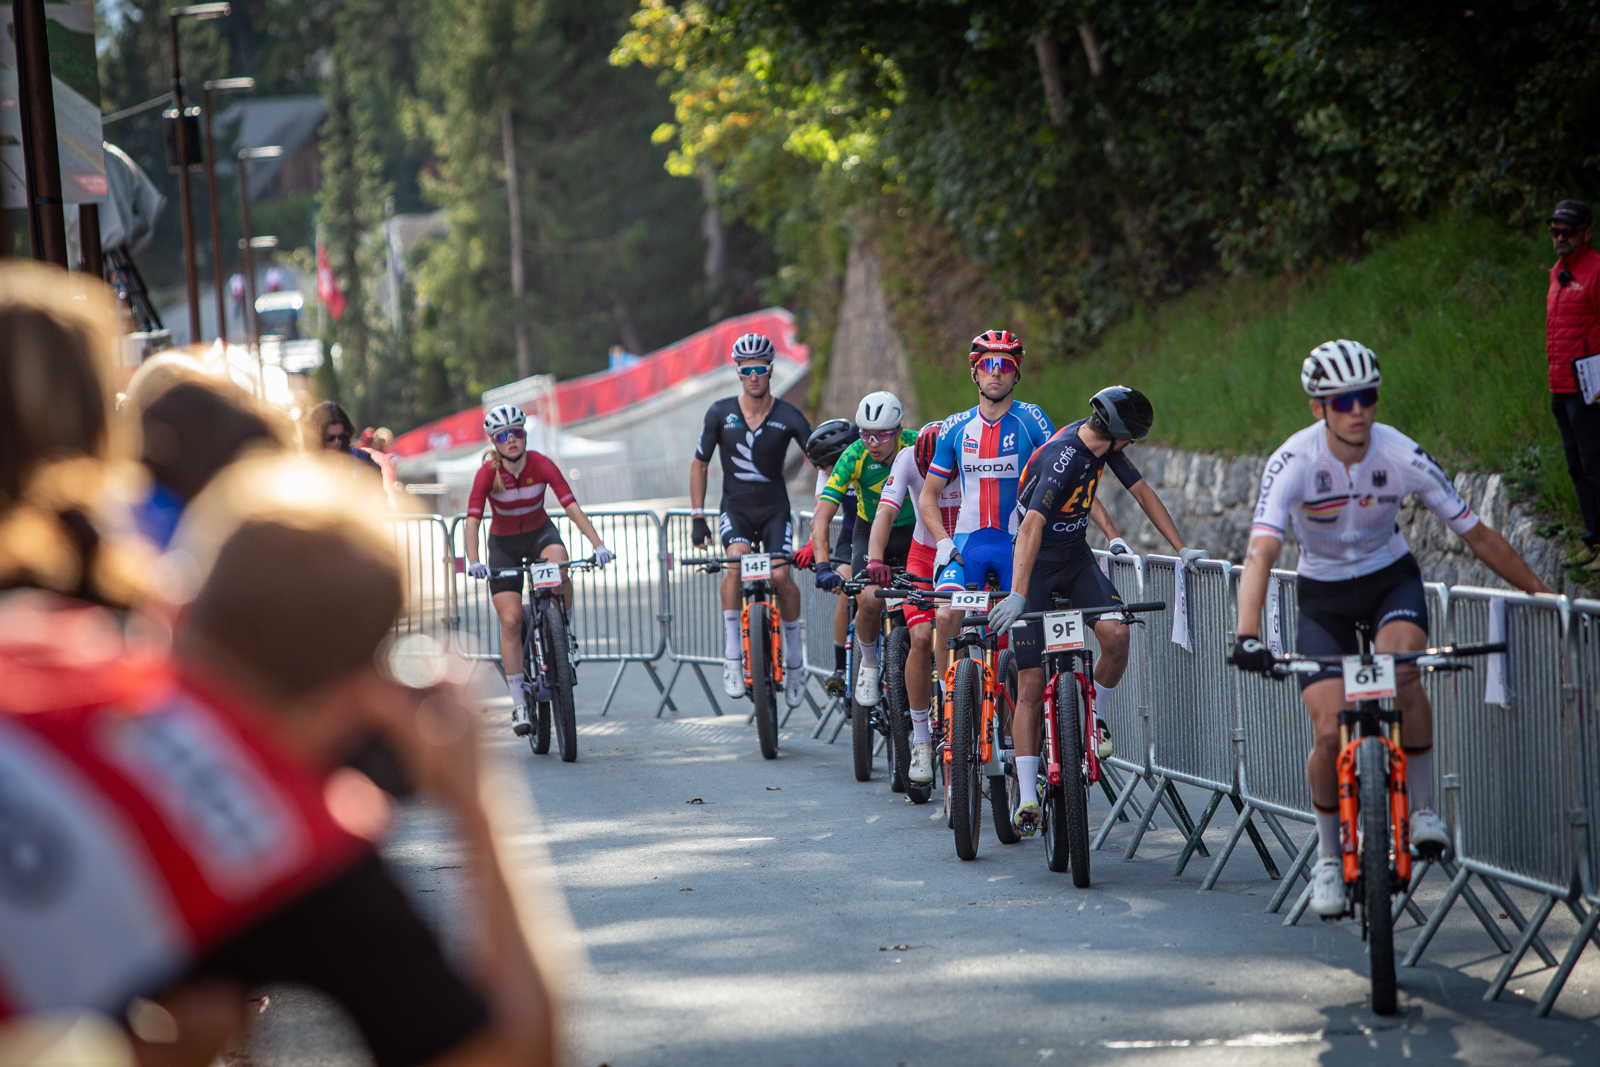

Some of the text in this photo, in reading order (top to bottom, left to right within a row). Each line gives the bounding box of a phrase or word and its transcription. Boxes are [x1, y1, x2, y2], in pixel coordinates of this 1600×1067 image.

[938, 411, 971, 441] sazka
[963, 462, 1015, 473] SKODA
[744, 560, 767, 572] 14F
[539, 569, 554, 579] 7F
[956, 595, 986, 604] 10F
[1052, 621, 1076, 639] 9F
[1355, 665, 1384, 685] 6F
